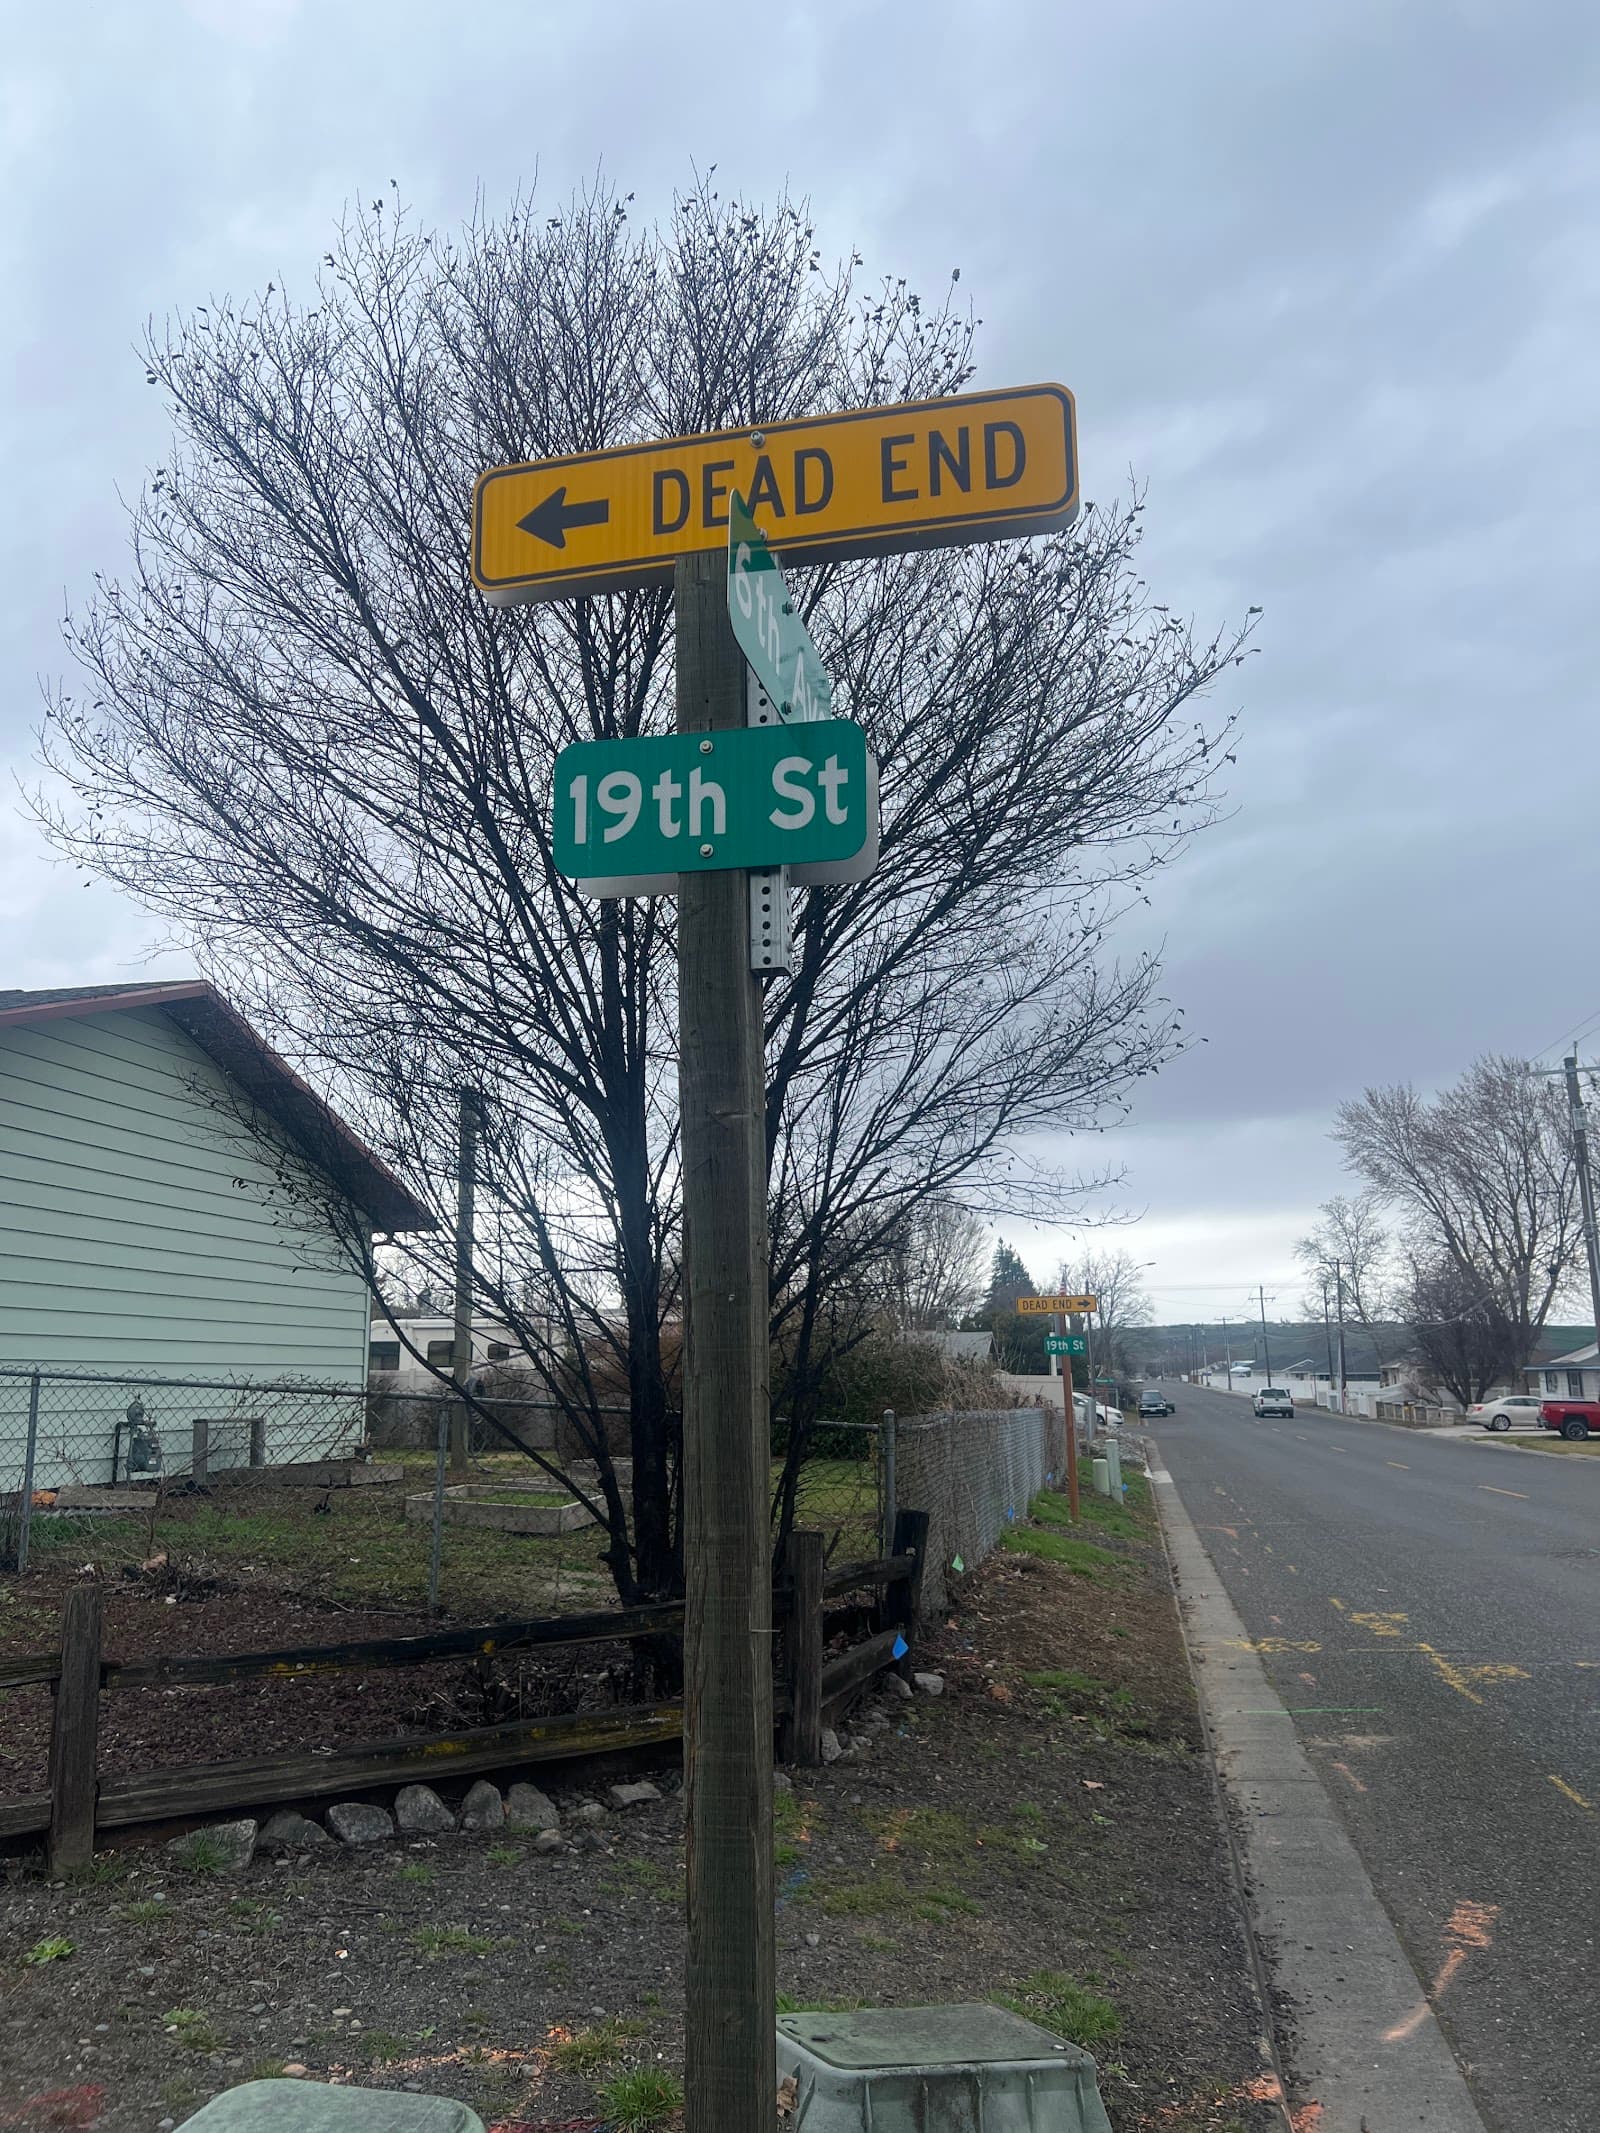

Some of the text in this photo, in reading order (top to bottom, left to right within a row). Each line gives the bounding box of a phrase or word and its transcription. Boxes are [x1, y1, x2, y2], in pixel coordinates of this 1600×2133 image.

[652, 420, 1027, 535] DEAD END
[735, 542, 826, 721] 6th Av
[569, 753, 849, 845] 19th St
[1022, 1299, 1072, 1311] DEAD END
[1046, 1340, 1084, 1351] 19th St
